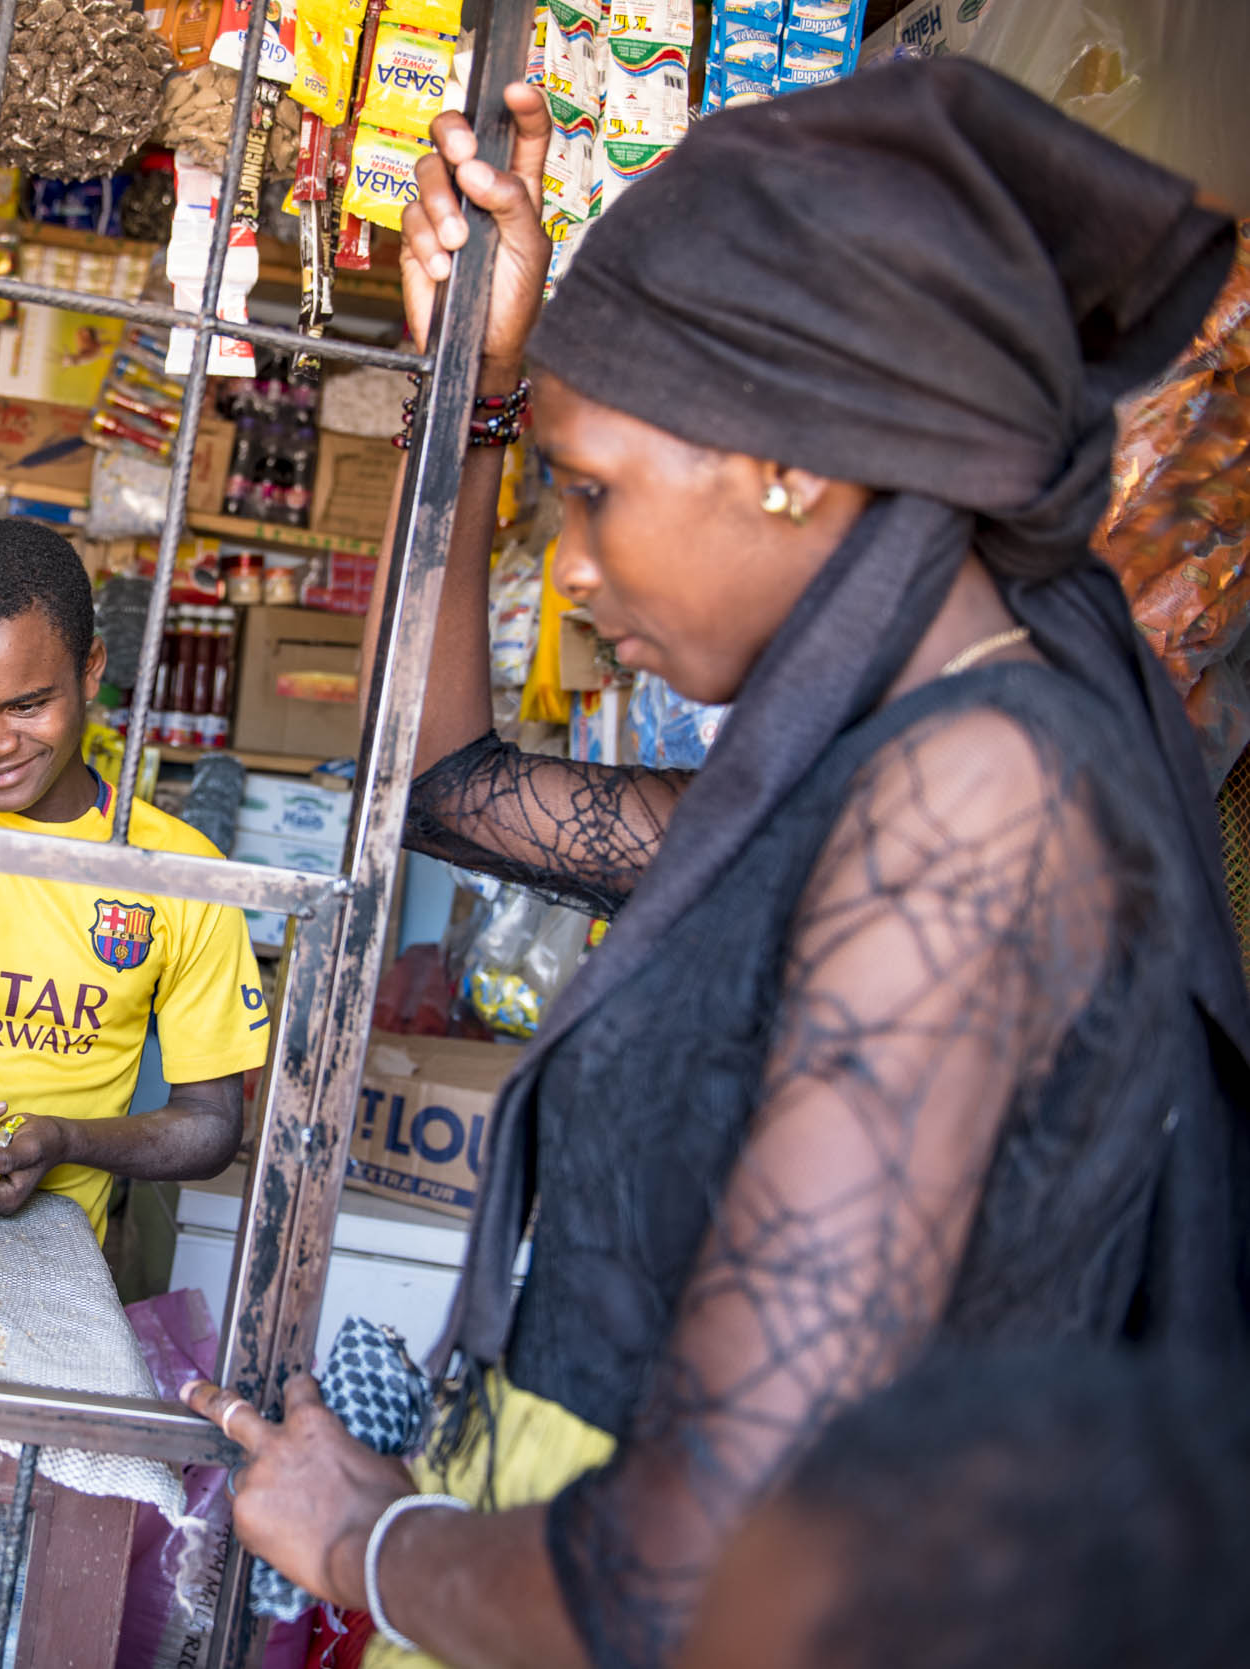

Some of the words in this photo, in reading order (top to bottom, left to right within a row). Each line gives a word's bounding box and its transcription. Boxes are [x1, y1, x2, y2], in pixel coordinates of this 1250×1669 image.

[238, 31, 288, 63] Gloa
[392, 55, 434, 72] POWER
[303, 76, 330, 98] SABA
[376, 63, 446, 97] SABA
[370, 161, 410, 178] POWER
[353, 164, 421, 204] SABA
[111, 930, 136, 941] FCB
[418, 1180, 456, 1202] PUR
